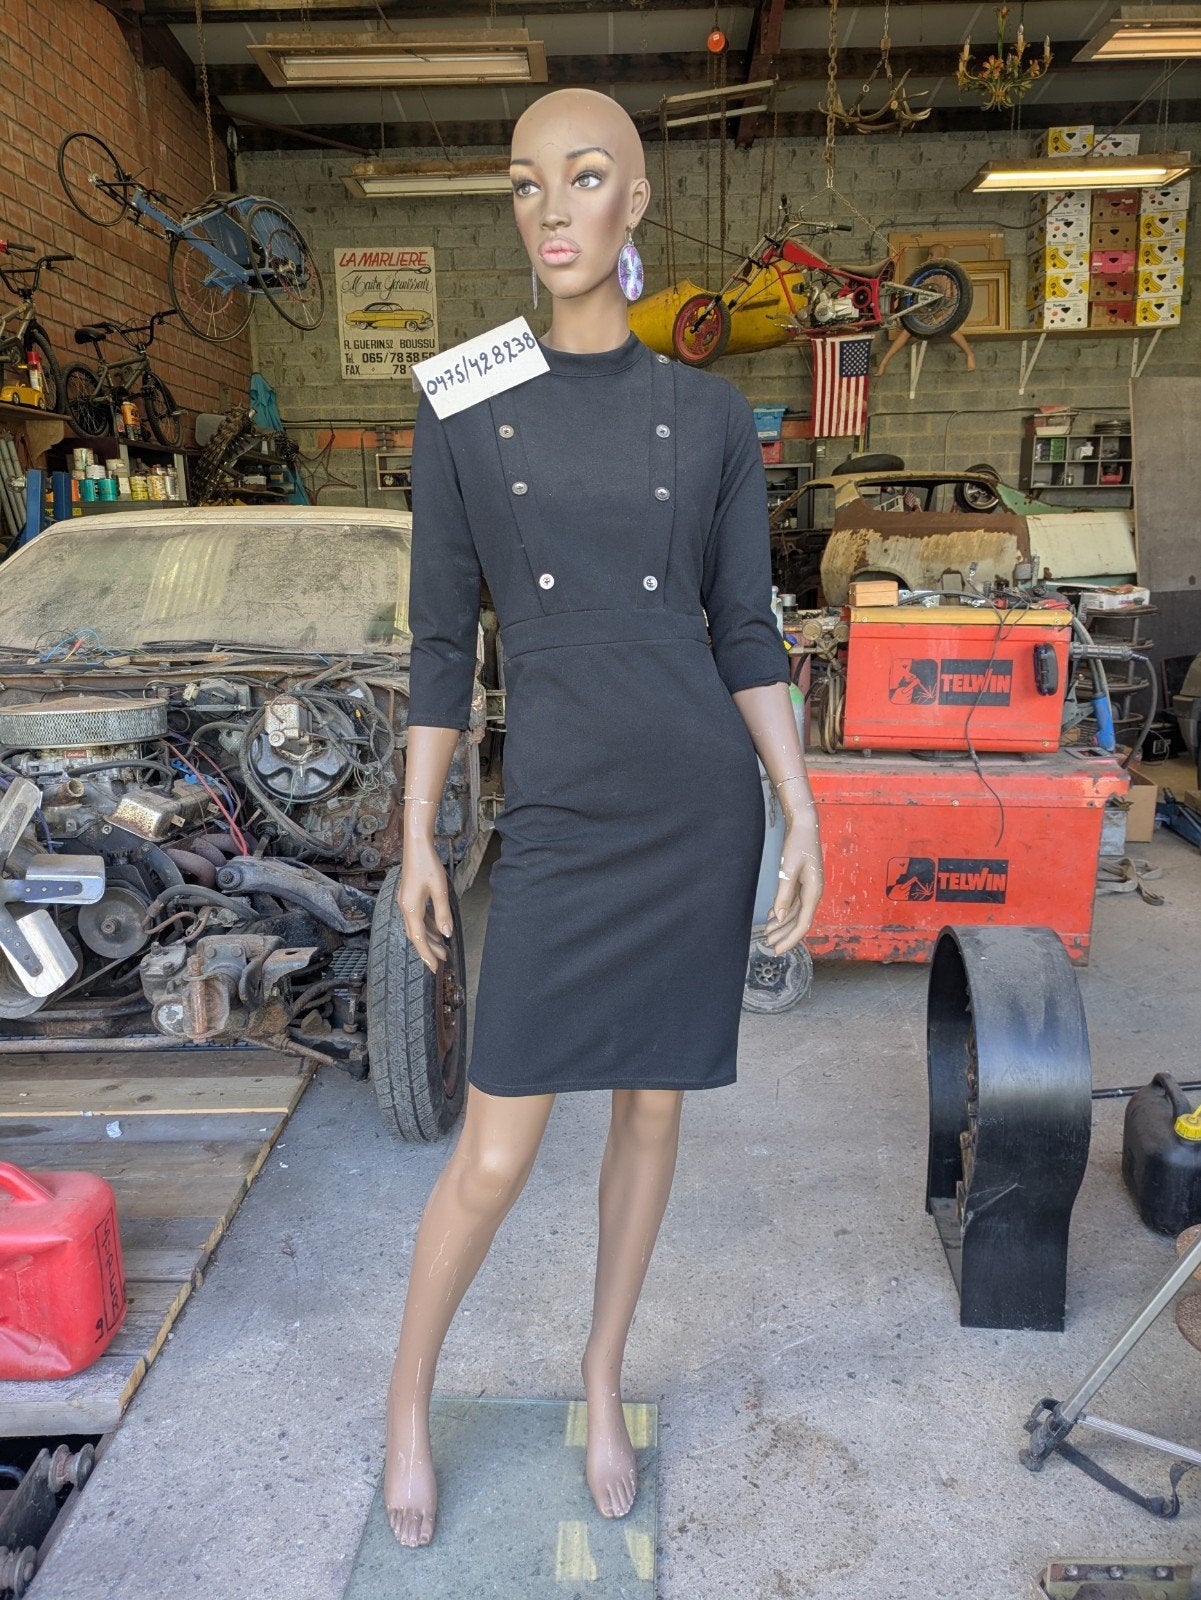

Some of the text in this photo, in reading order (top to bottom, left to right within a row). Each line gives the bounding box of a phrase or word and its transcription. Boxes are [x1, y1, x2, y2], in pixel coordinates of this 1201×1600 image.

[339, 251, 428, 267] LA MARLIERE
[400, 339, 435, 349] BOUSSU
[345, 365, 361, 375] FAX
[426, 332, 535, 395] 0475/428238
[941, 668, 1011, 693] TELWIN
[938, 867, 1006, 891] TELWIN
